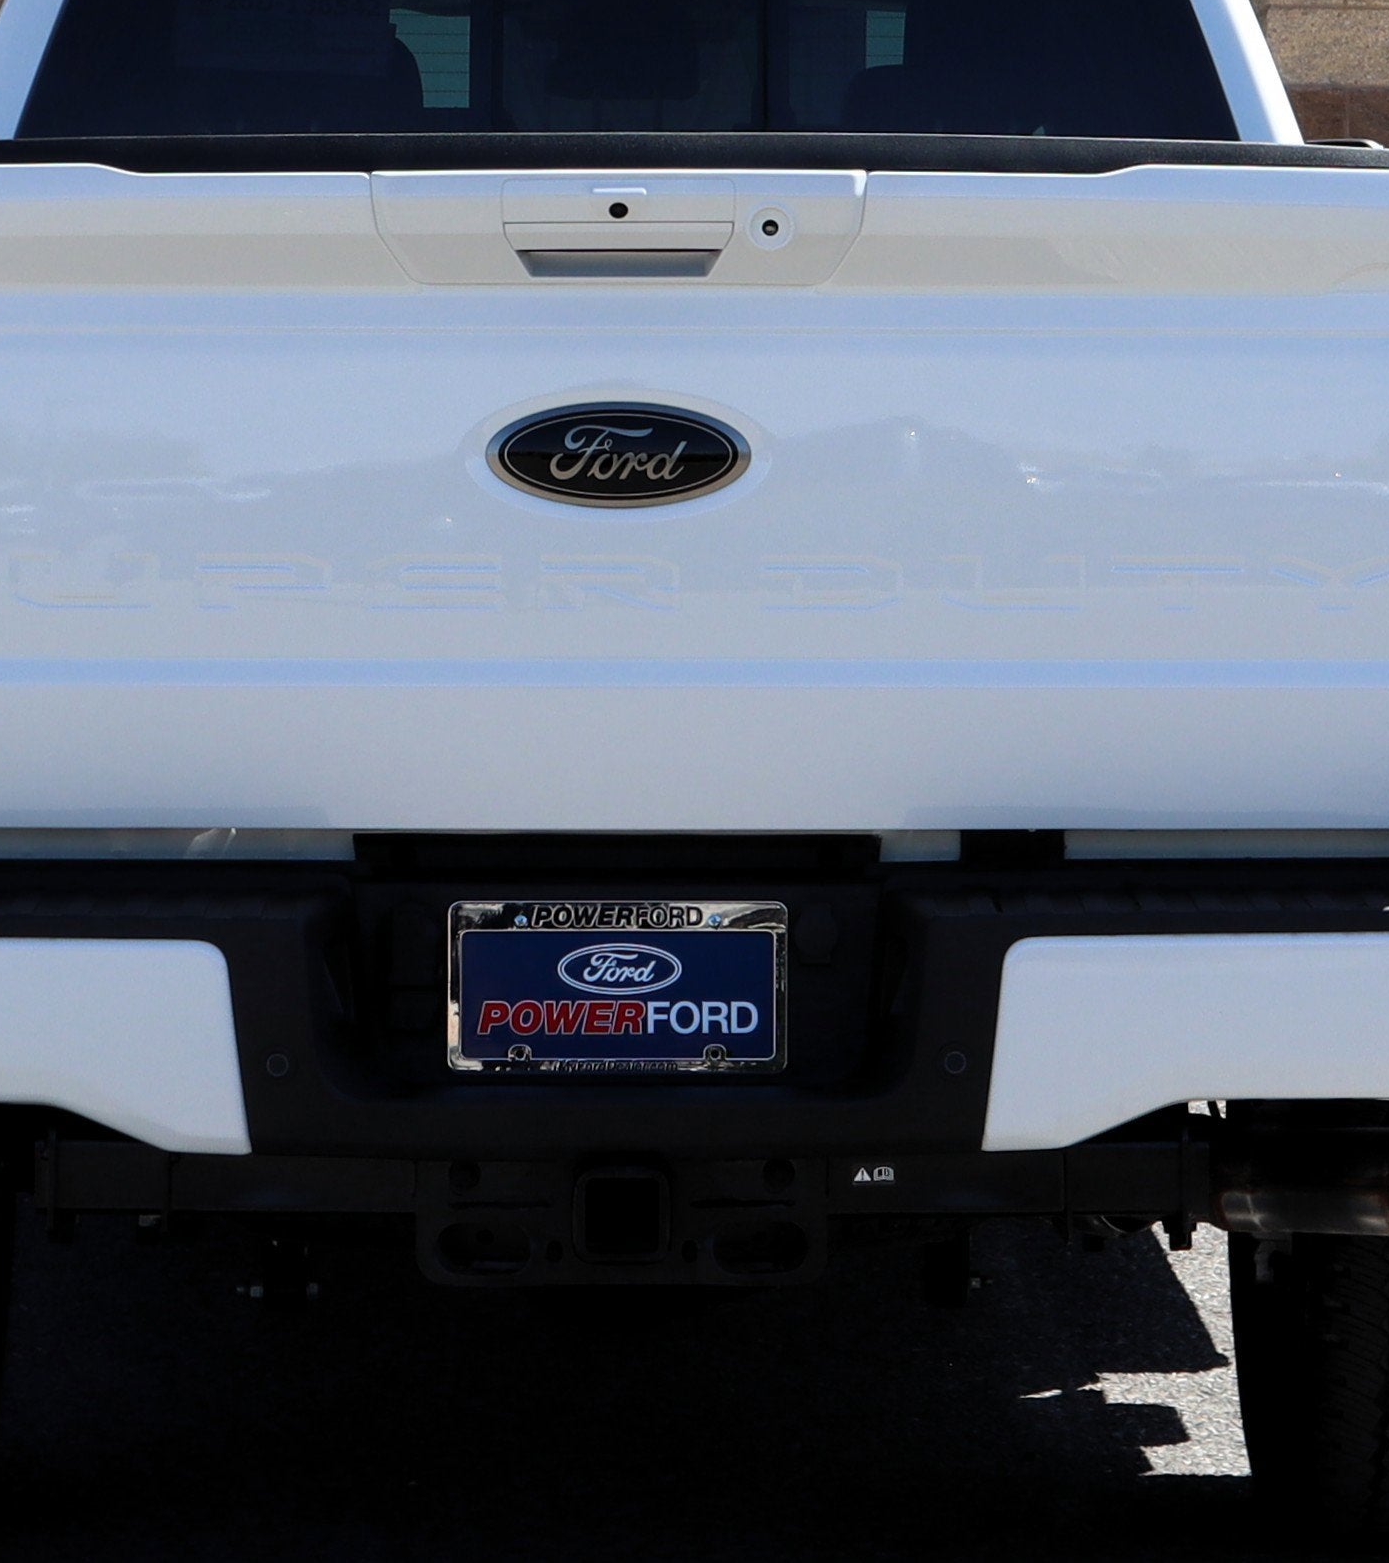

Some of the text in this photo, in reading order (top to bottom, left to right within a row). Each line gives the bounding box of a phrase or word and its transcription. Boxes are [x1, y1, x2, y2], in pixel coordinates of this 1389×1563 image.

[549, 423, 688, 481] Ford
[531, 903, 704, 929] POWERFORD
[582, 952, 657, 985] Ford
[477, 999, 759, 1036] POWERFORD
